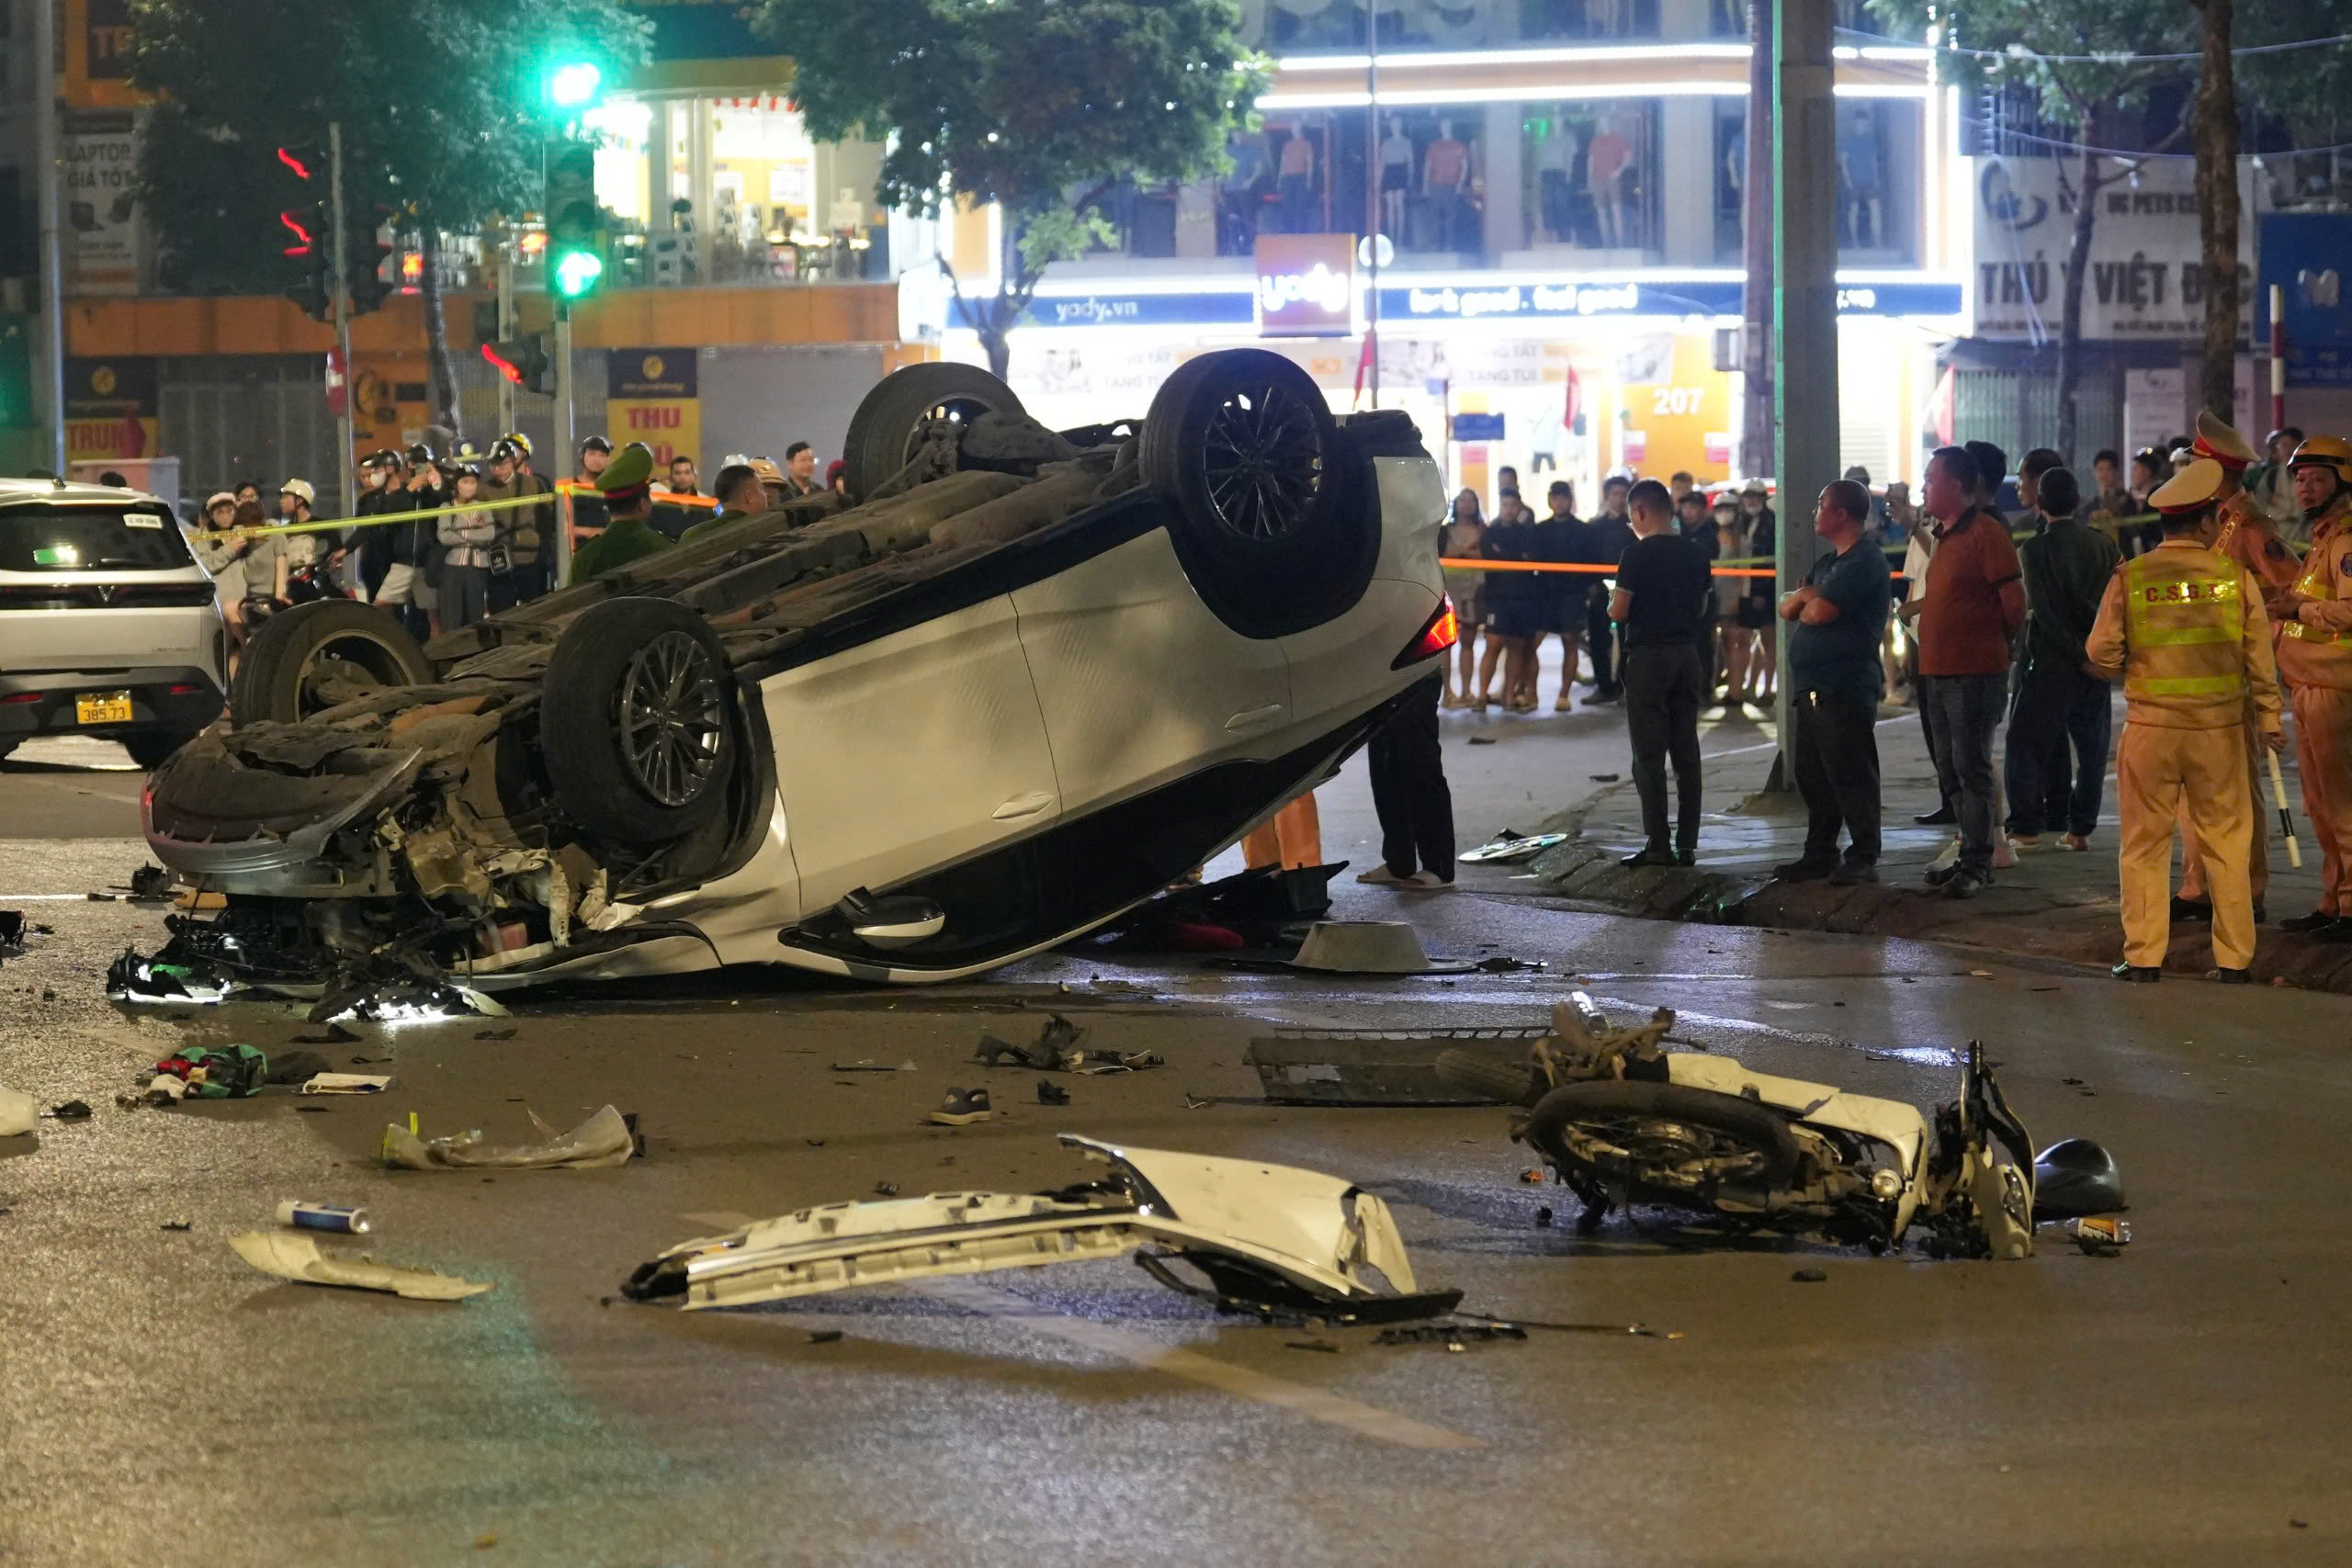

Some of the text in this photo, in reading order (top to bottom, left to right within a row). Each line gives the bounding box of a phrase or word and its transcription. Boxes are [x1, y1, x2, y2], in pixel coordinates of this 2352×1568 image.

[1980, 249, 2049, 304] THÚ
[2092, 250, 2168, 312] VIỆT
[1653, 387, 1705, 415] 207
[626, 407, 681, 429] THU
[84, 706, 126, 722] 385.73
